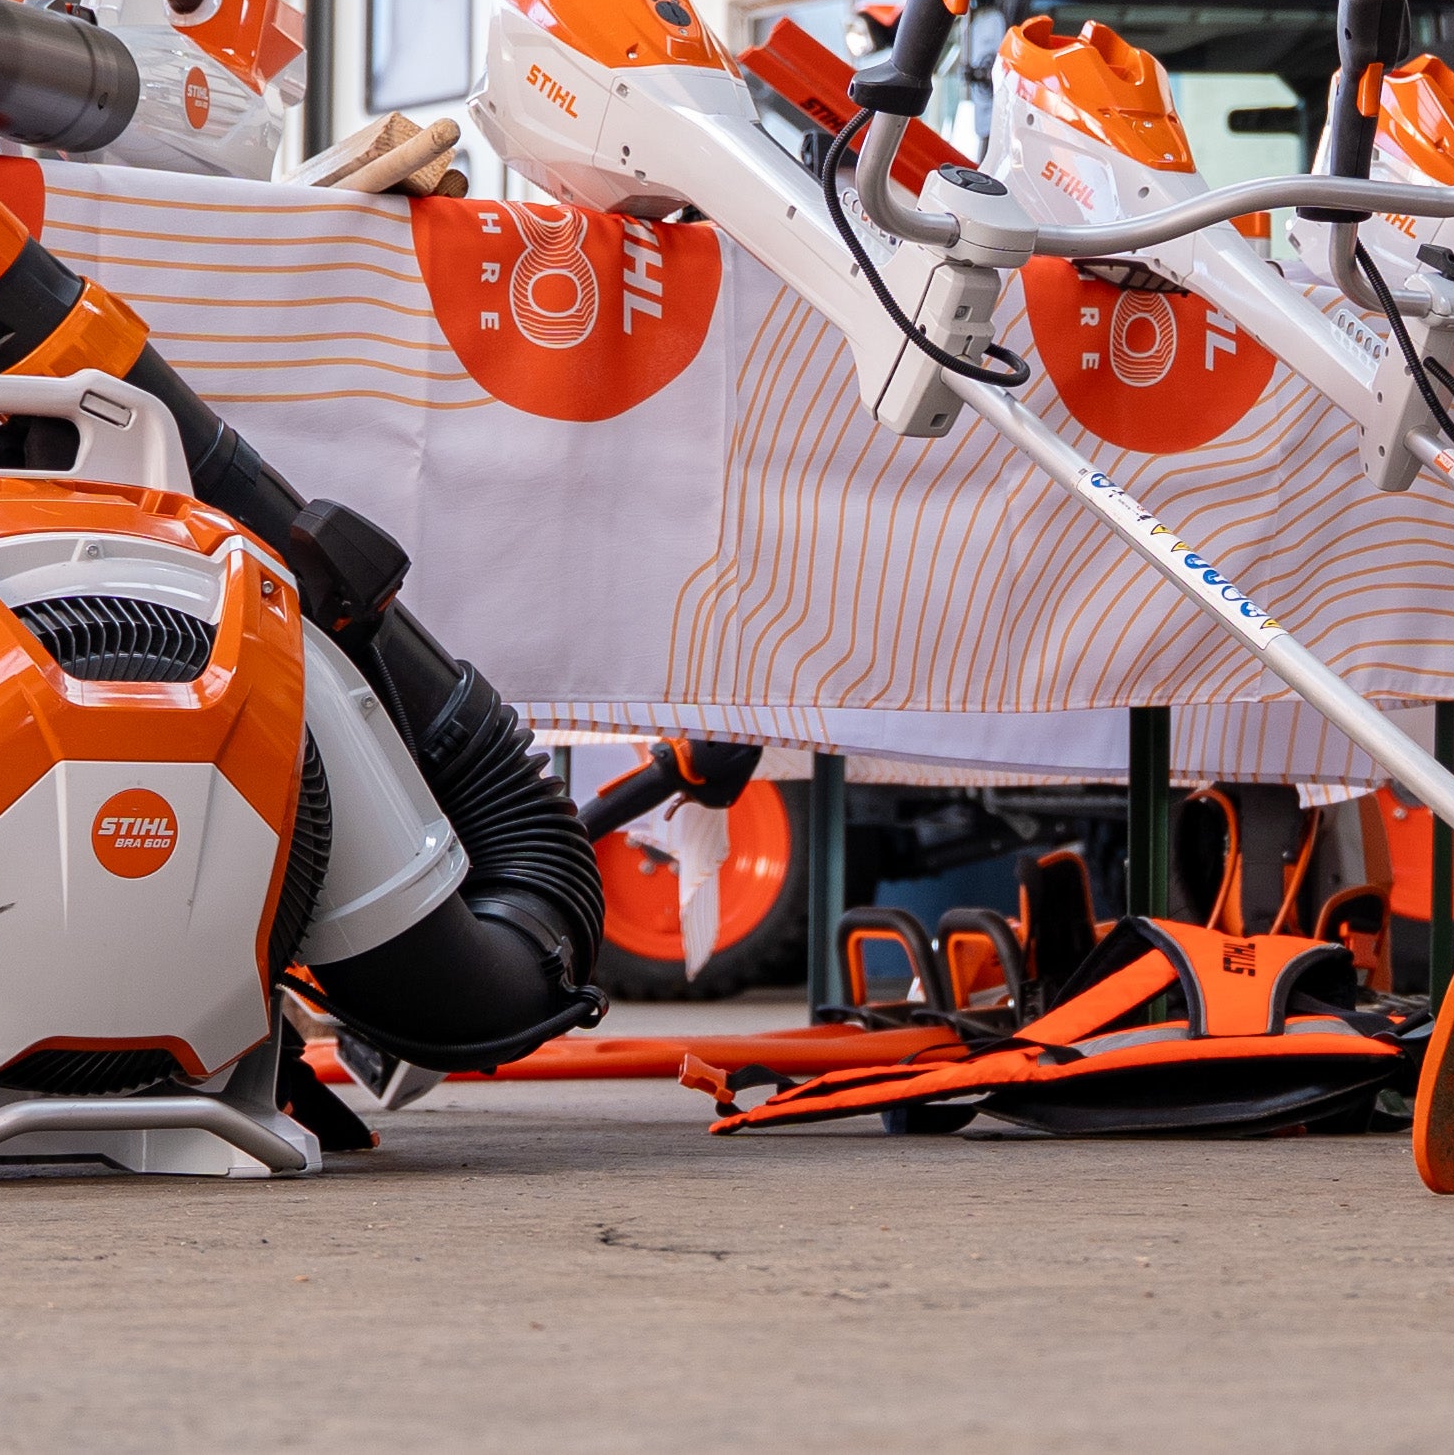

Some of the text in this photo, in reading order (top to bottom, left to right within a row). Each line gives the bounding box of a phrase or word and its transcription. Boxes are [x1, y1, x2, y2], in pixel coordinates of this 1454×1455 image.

[526, 64, 579, 119] STIHL
[799, 97, 847, 133] STIH
[1041, 160, 1095, 210] STIHL
[622, 218, 664, 336] IHL
[97, 817, 175, 837] STIHL
[114, 838, 142, 849] BRA
[1222, 942, 1256, 977] STIHL
